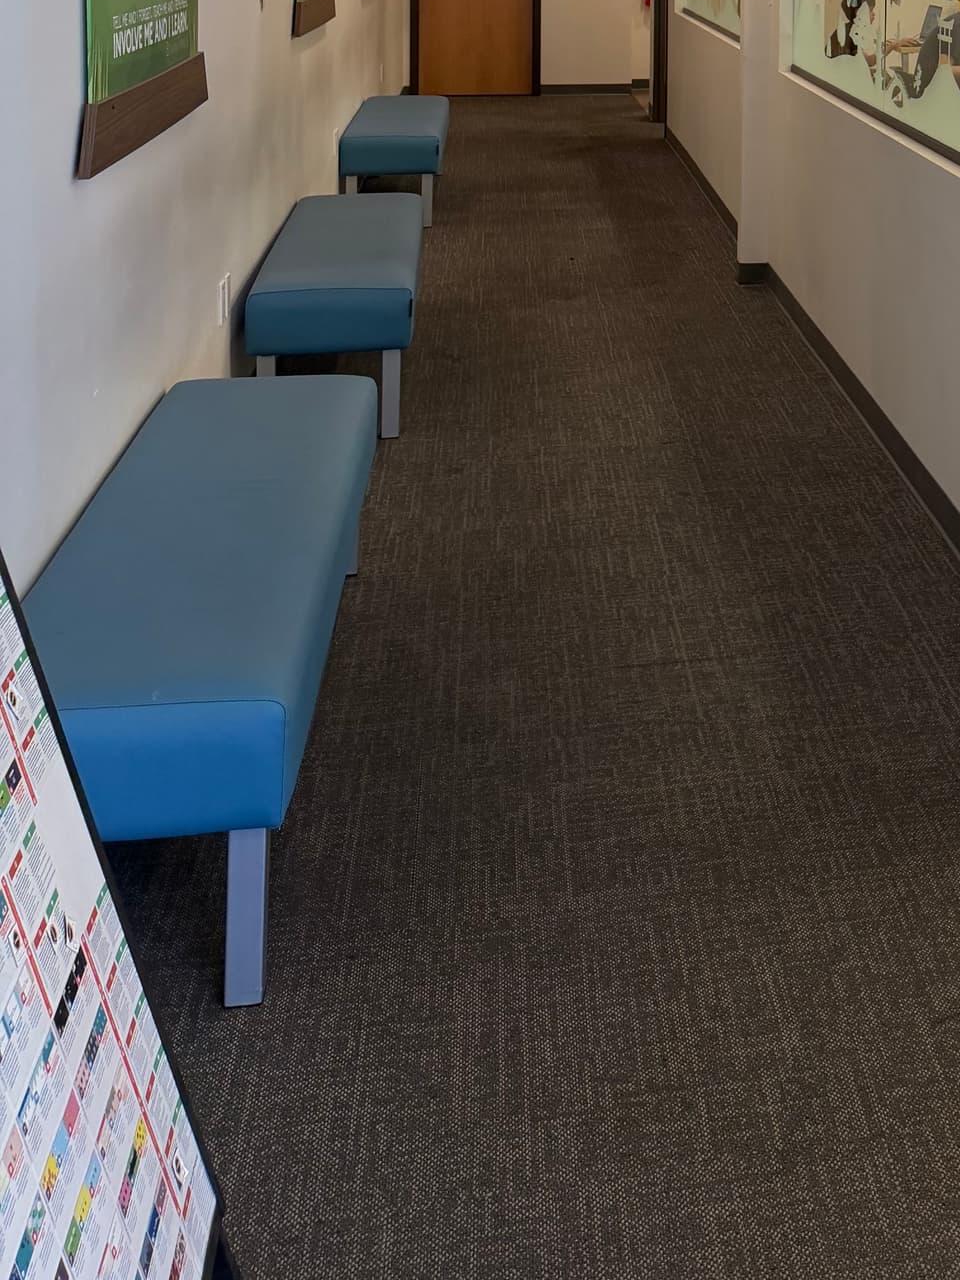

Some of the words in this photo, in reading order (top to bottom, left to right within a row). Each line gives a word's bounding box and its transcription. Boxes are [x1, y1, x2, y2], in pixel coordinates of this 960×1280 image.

[113, 24, 143, 60] INVOLVE
[144, 21, 154, 48] ME
[154, 17, 168, 44] AND
